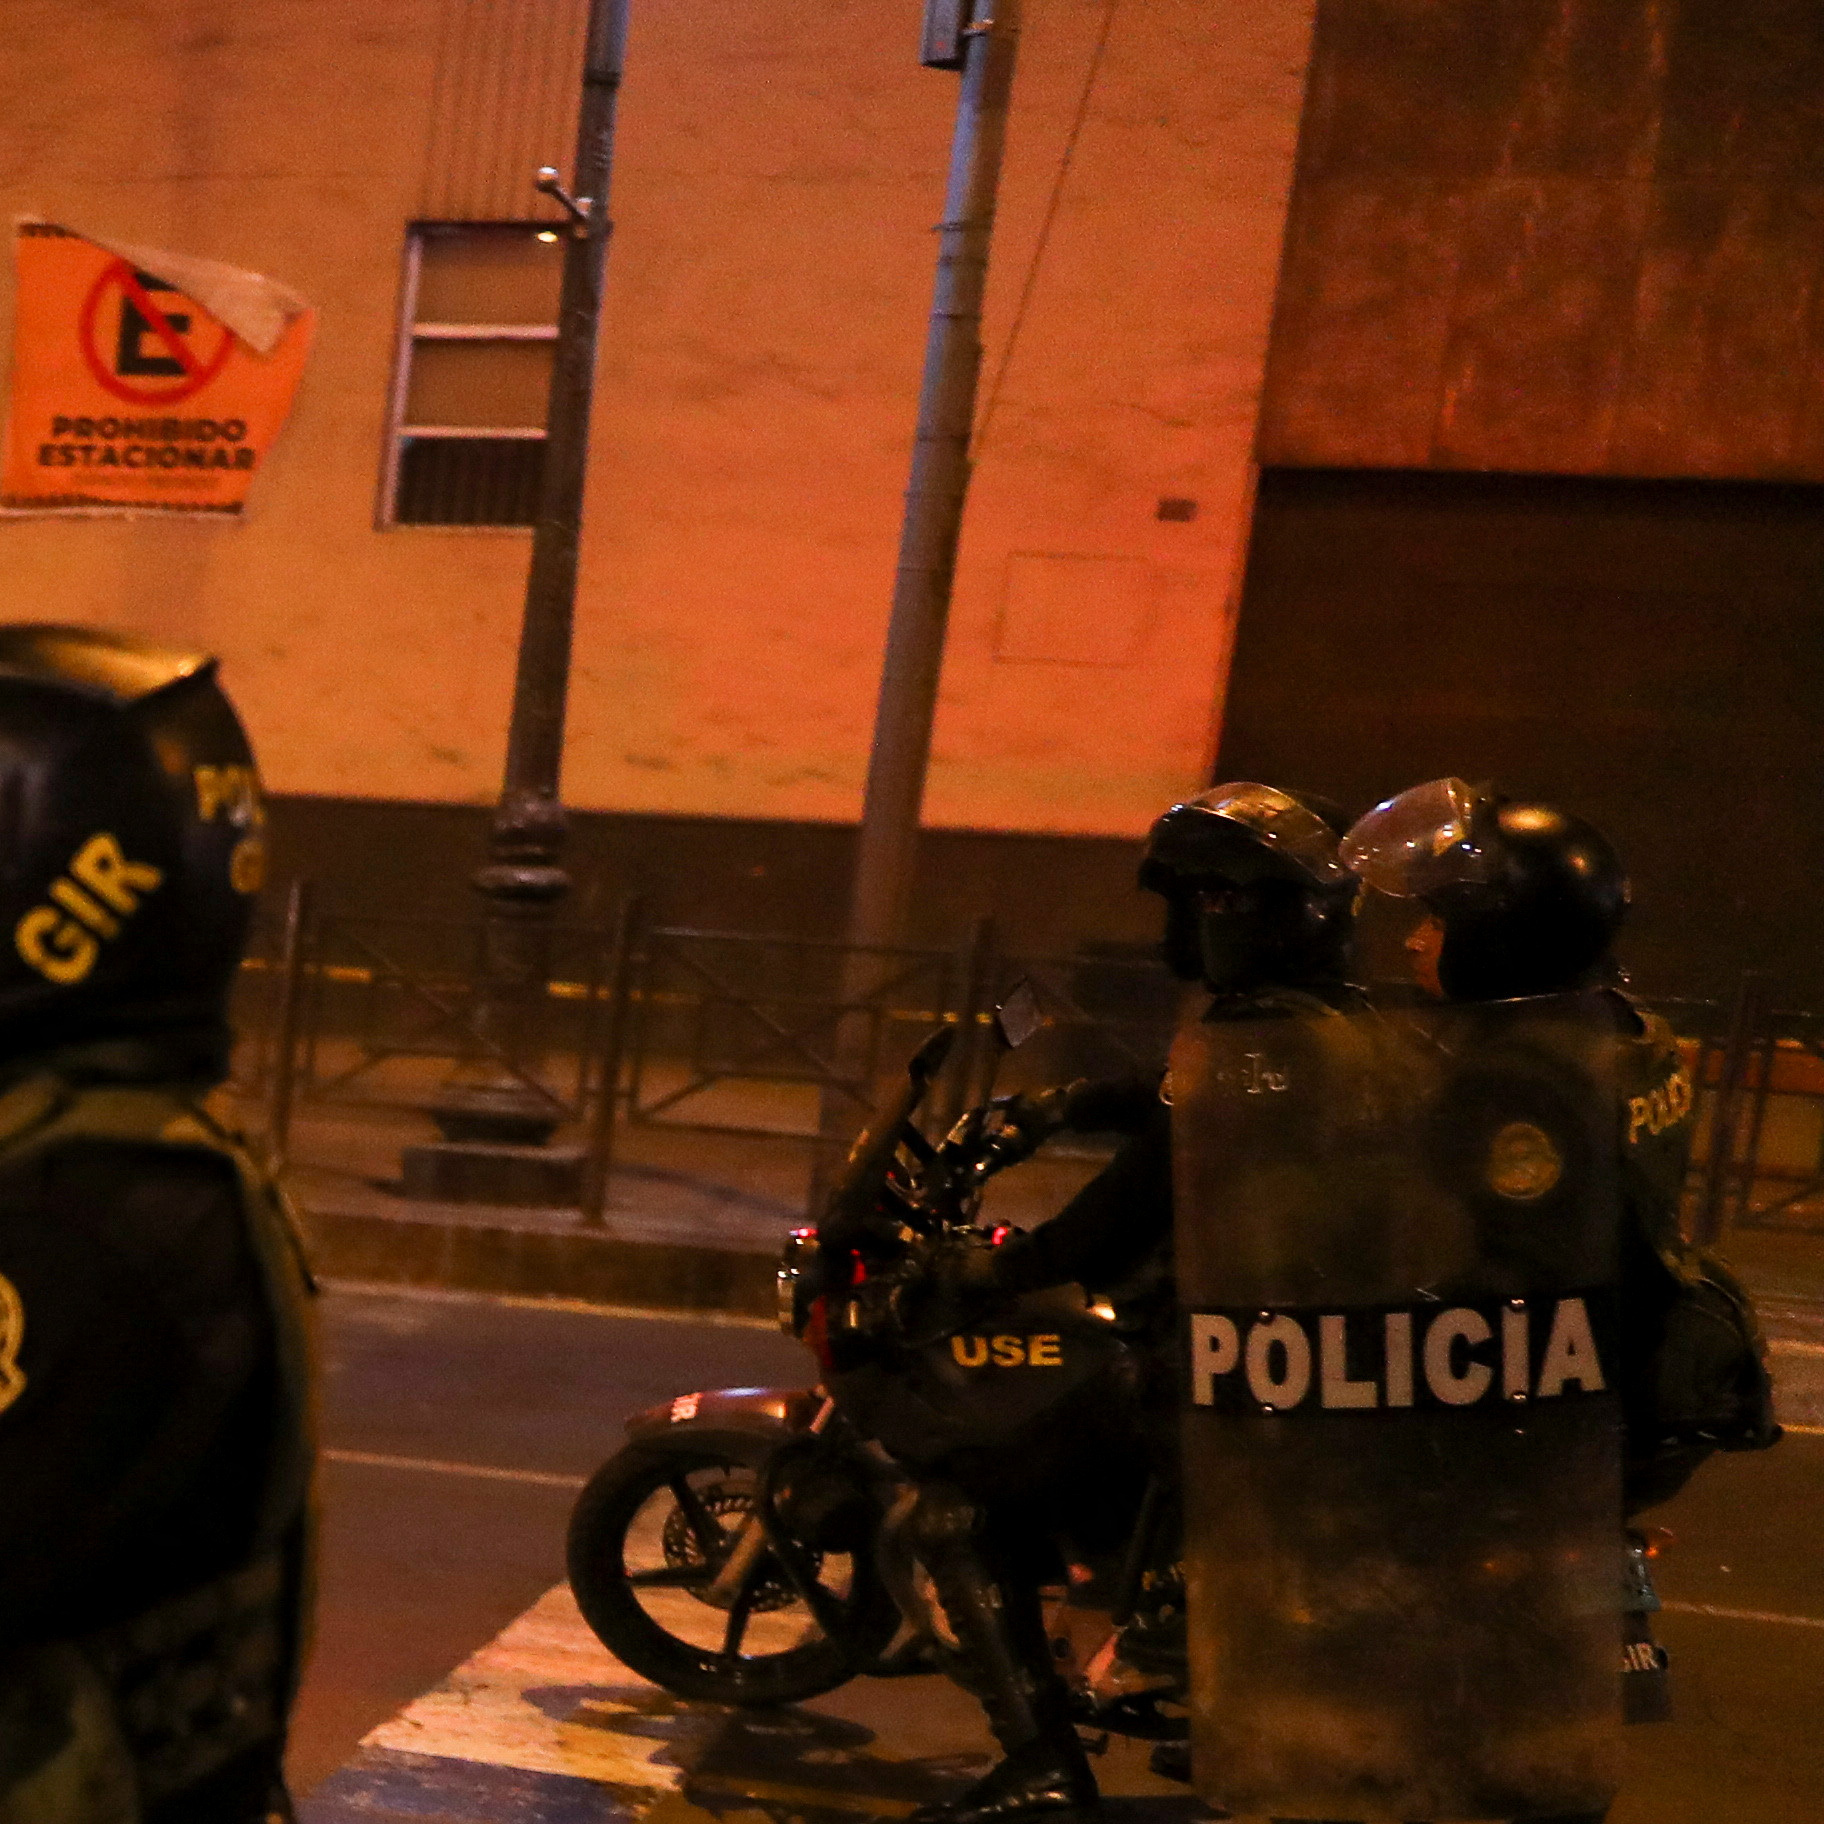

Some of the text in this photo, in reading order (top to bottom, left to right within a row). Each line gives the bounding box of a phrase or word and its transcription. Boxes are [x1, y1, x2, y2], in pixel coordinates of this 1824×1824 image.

[52, 416, 248, 443] PROHIBIDO
[37, 444, 256, 470] ESTACIONAR
[14, 831, 165, 986] GIR
[950, 1333, 1065, 1368] USE
[1190, 1297, 1607, 1411] POLICIA
